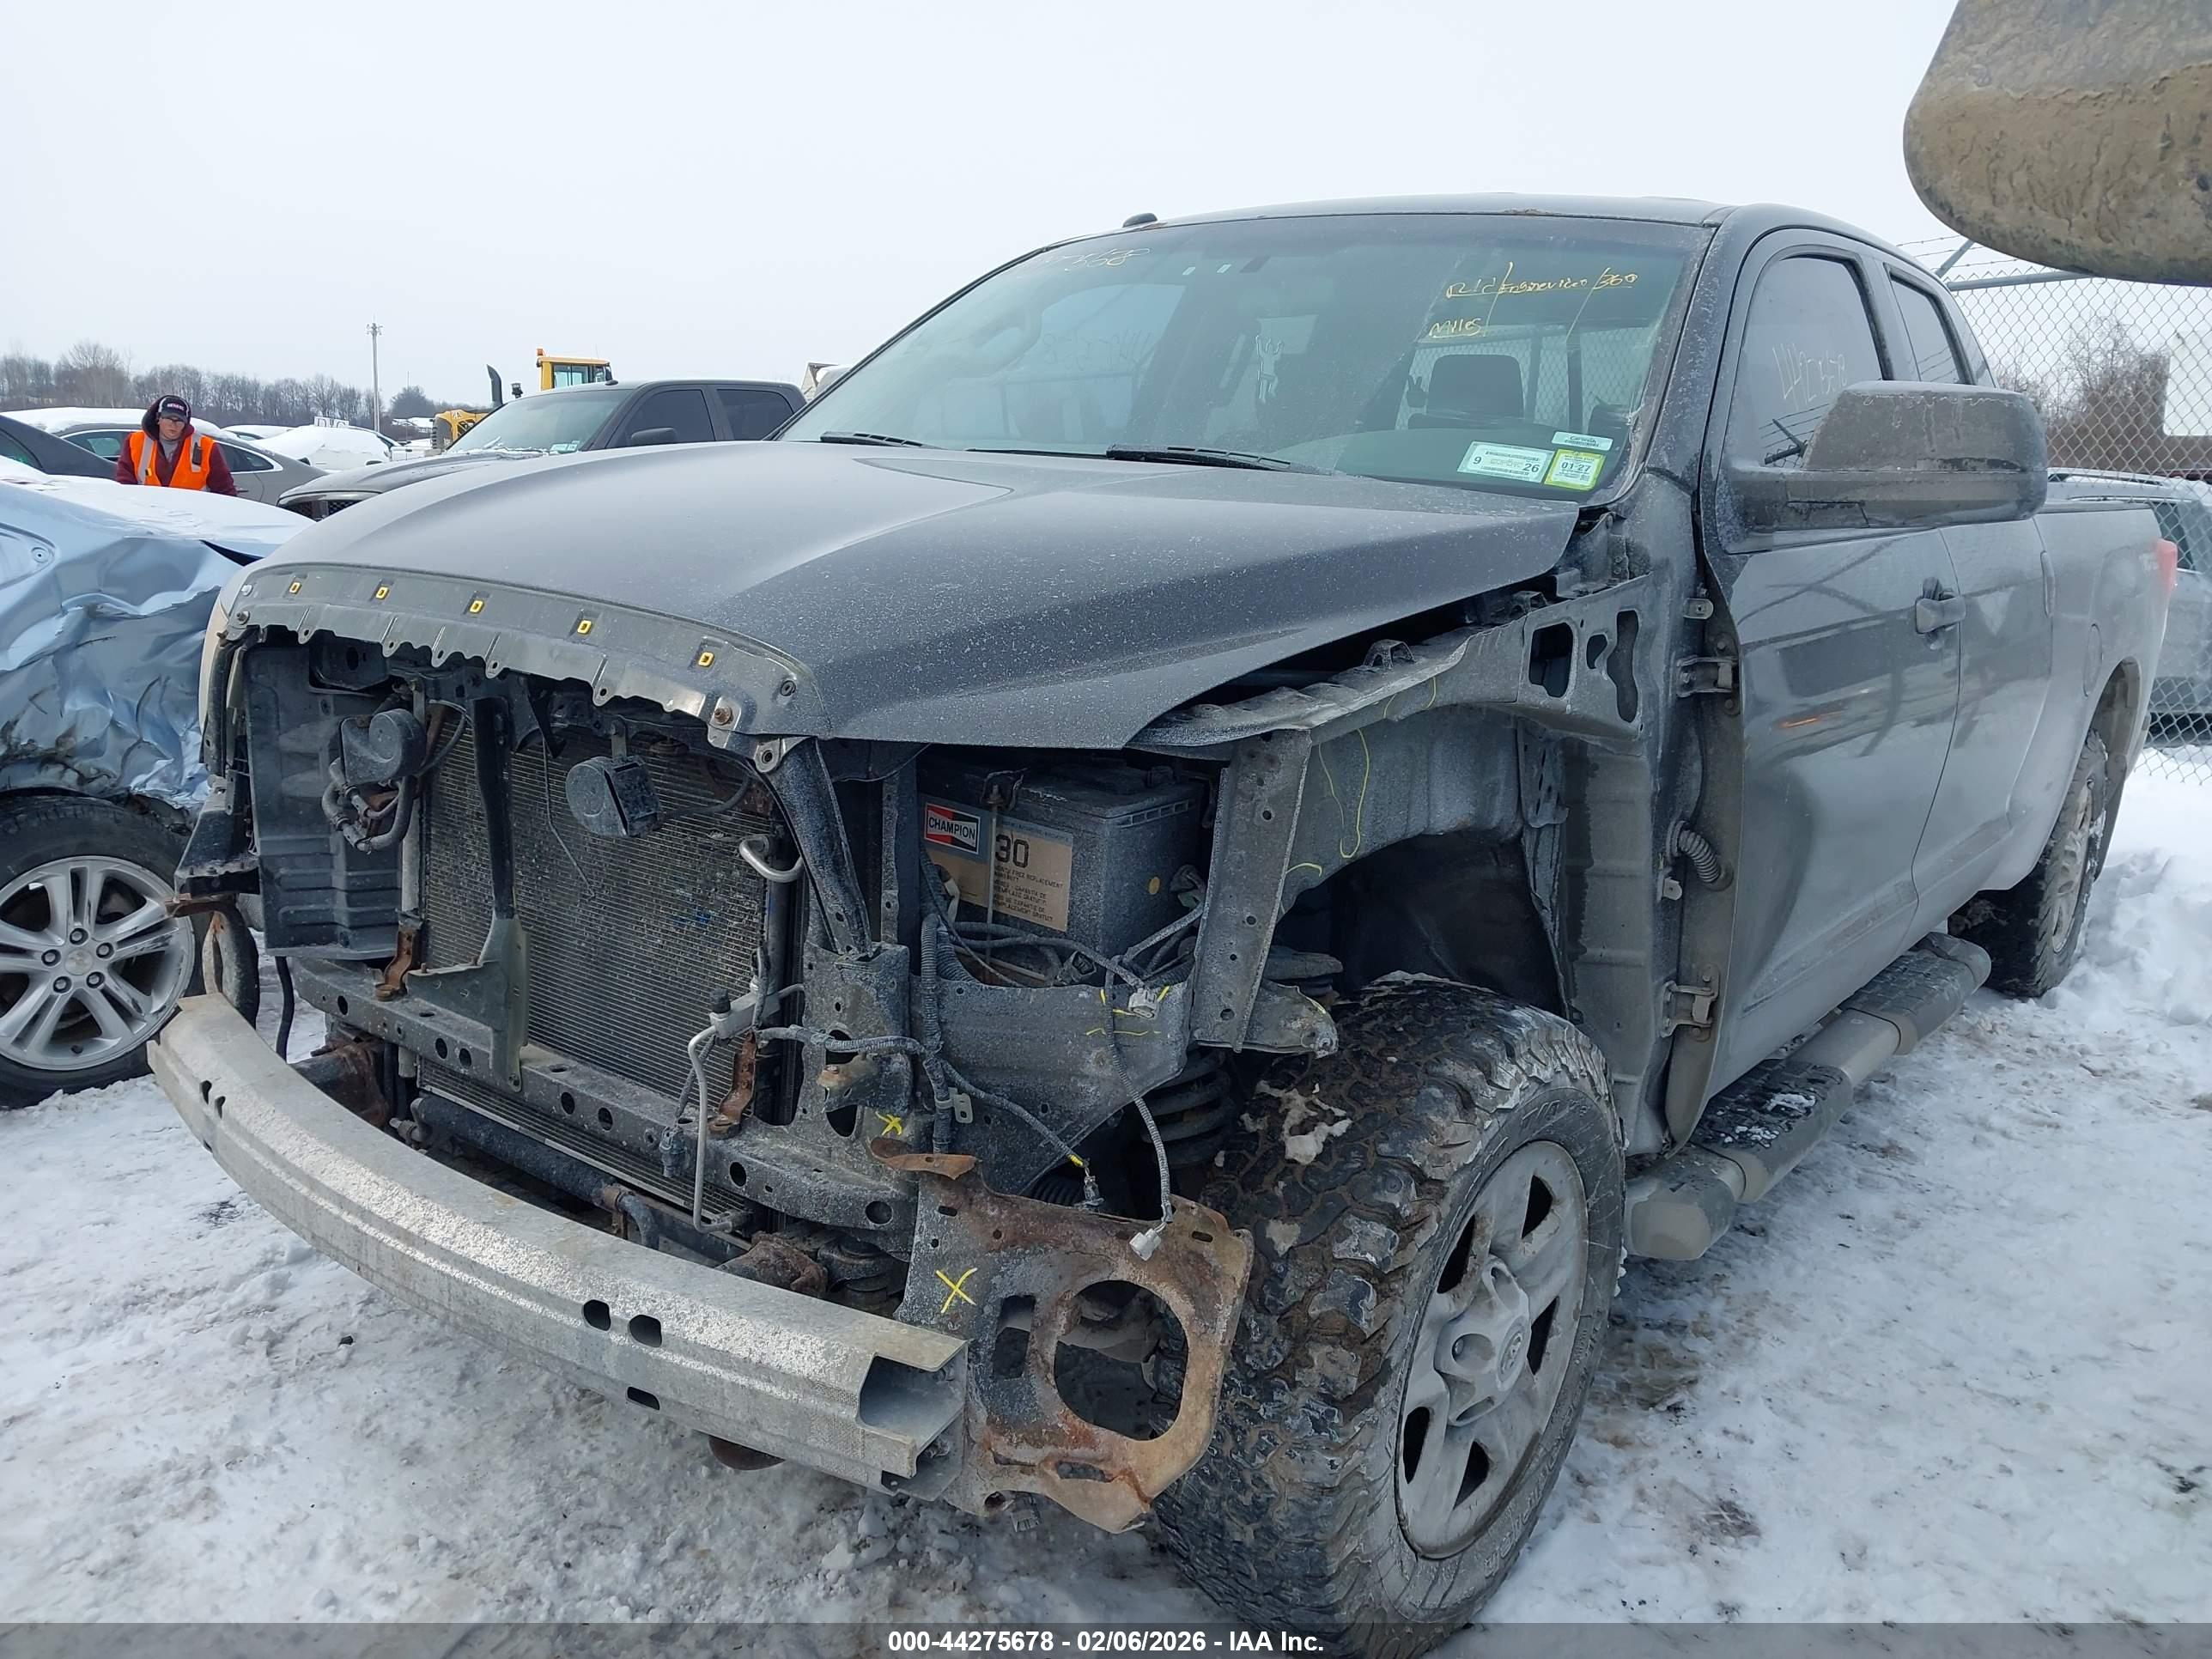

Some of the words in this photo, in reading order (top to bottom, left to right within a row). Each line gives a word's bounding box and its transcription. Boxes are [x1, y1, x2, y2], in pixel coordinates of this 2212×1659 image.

[1473, 456, 1482, 465] 9
[1522, 463, 1540, 473] 26
[928, 817, 975, 840] CHAMPION
[995, 834, 1030, 869] 30
